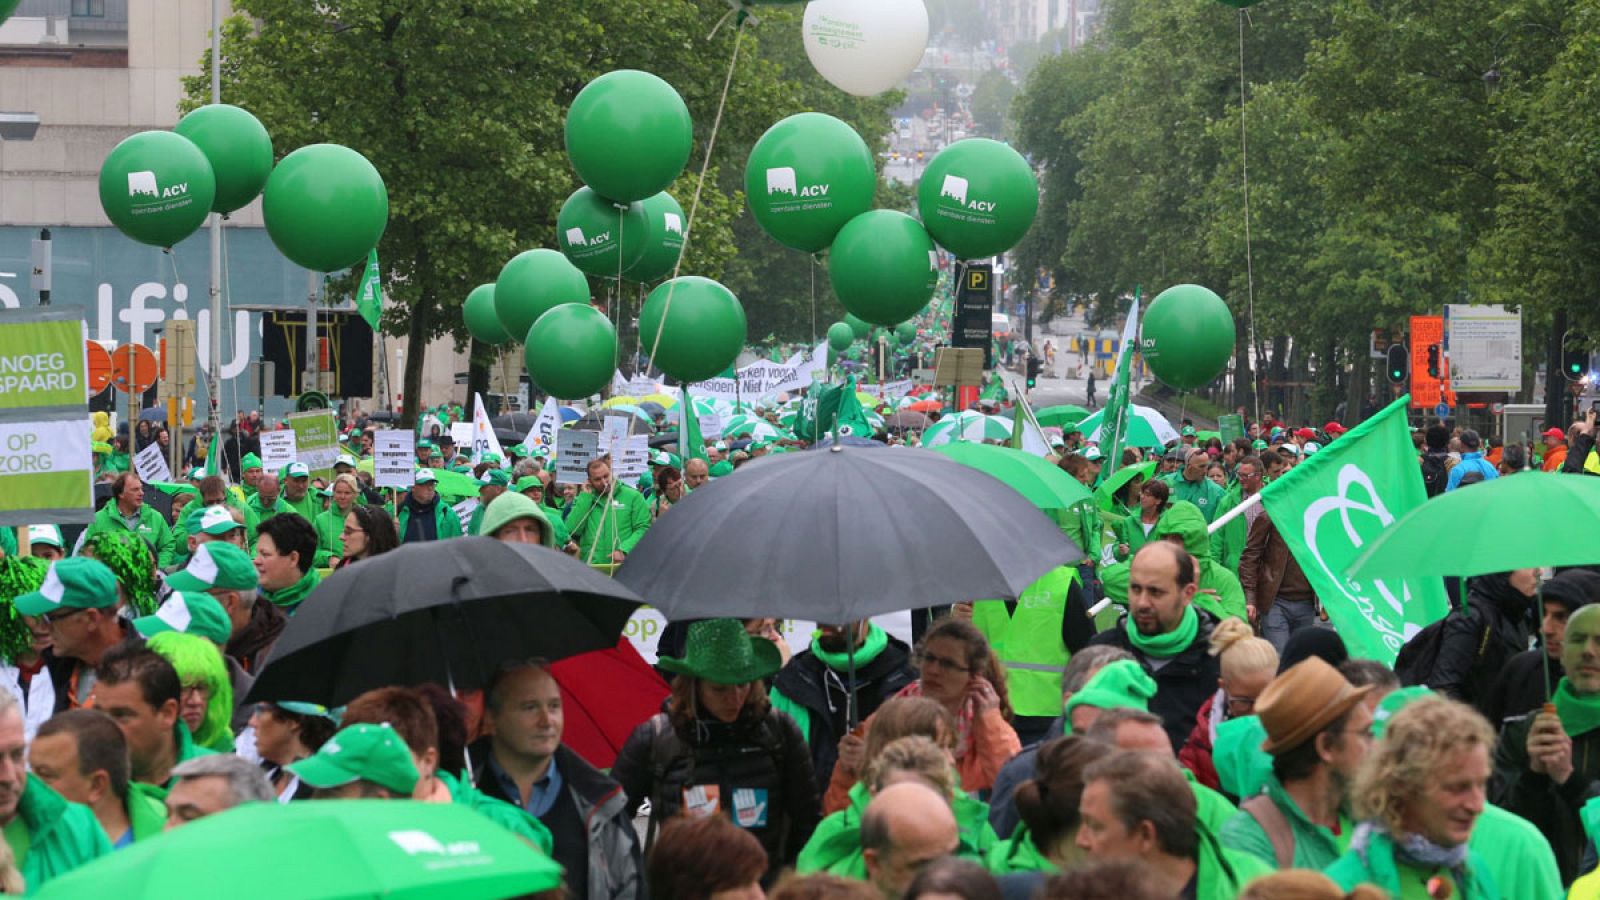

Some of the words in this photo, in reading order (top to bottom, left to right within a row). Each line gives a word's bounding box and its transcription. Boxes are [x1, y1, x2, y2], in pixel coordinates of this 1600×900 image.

[162, 183, 188, 198] ACV
[800, 184, 829, 197] ACV
[967, 200, 996, 212] ACV
[590, 231, 610, 246] ACV
[971, 272, 984, 288] P
[0, 352, 65, 373] NOEG
[737, 367, 765, 379] erken
[8, 433, 37, 451] OP
